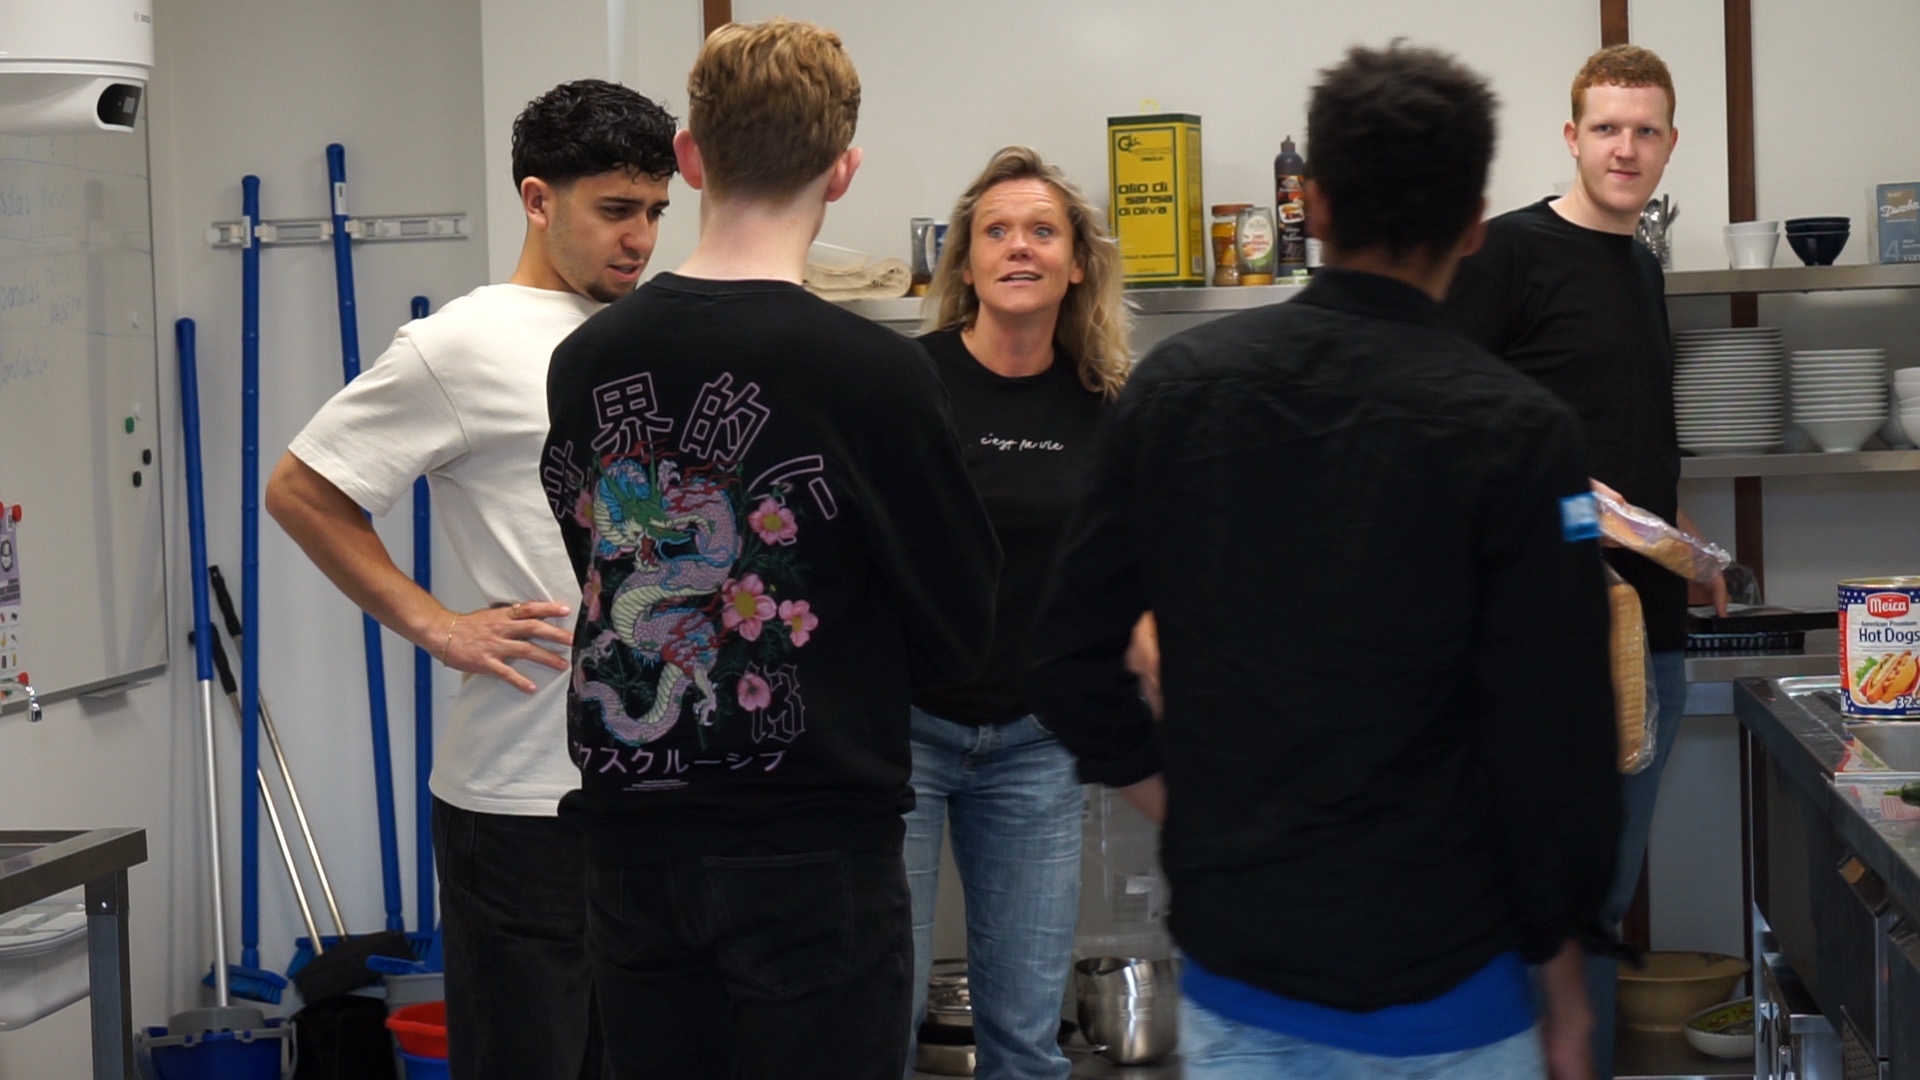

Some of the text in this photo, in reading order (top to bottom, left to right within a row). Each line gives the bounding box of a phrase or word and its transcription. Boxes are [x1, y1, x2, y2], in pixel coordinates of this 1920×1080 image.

[1118, 181, 1168, 194] olio di
[1118, 205, 1168, 217] di oliva
[1870, 597, 1907, 613] Meica
[1859, 627, 1920, 645] Hot Dogs
